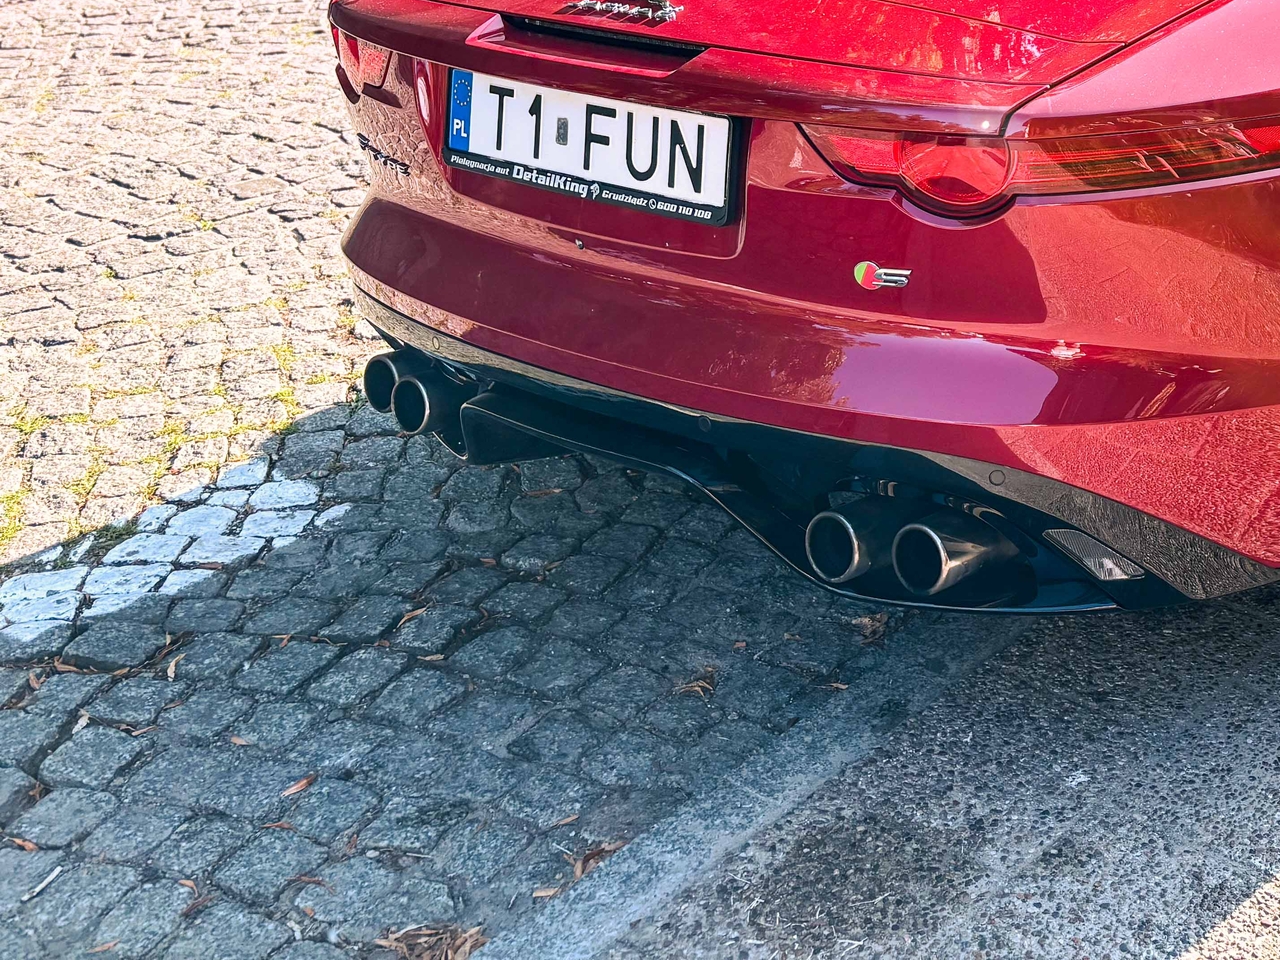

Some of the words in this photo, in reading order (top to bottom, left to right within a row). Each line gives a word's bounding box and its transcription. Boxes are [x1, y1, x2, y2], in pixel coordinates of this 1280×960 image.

[452, 118, 468, 138] PL
[489, 84, 543, 159] T1
[583, 104, 705, 194] FUN
[495, 166, 510, 176] aut
[512, 164, 589, 198] DetailKing
[656, 202, 677, 214] 600
[677, 204, 693, 216] 110
